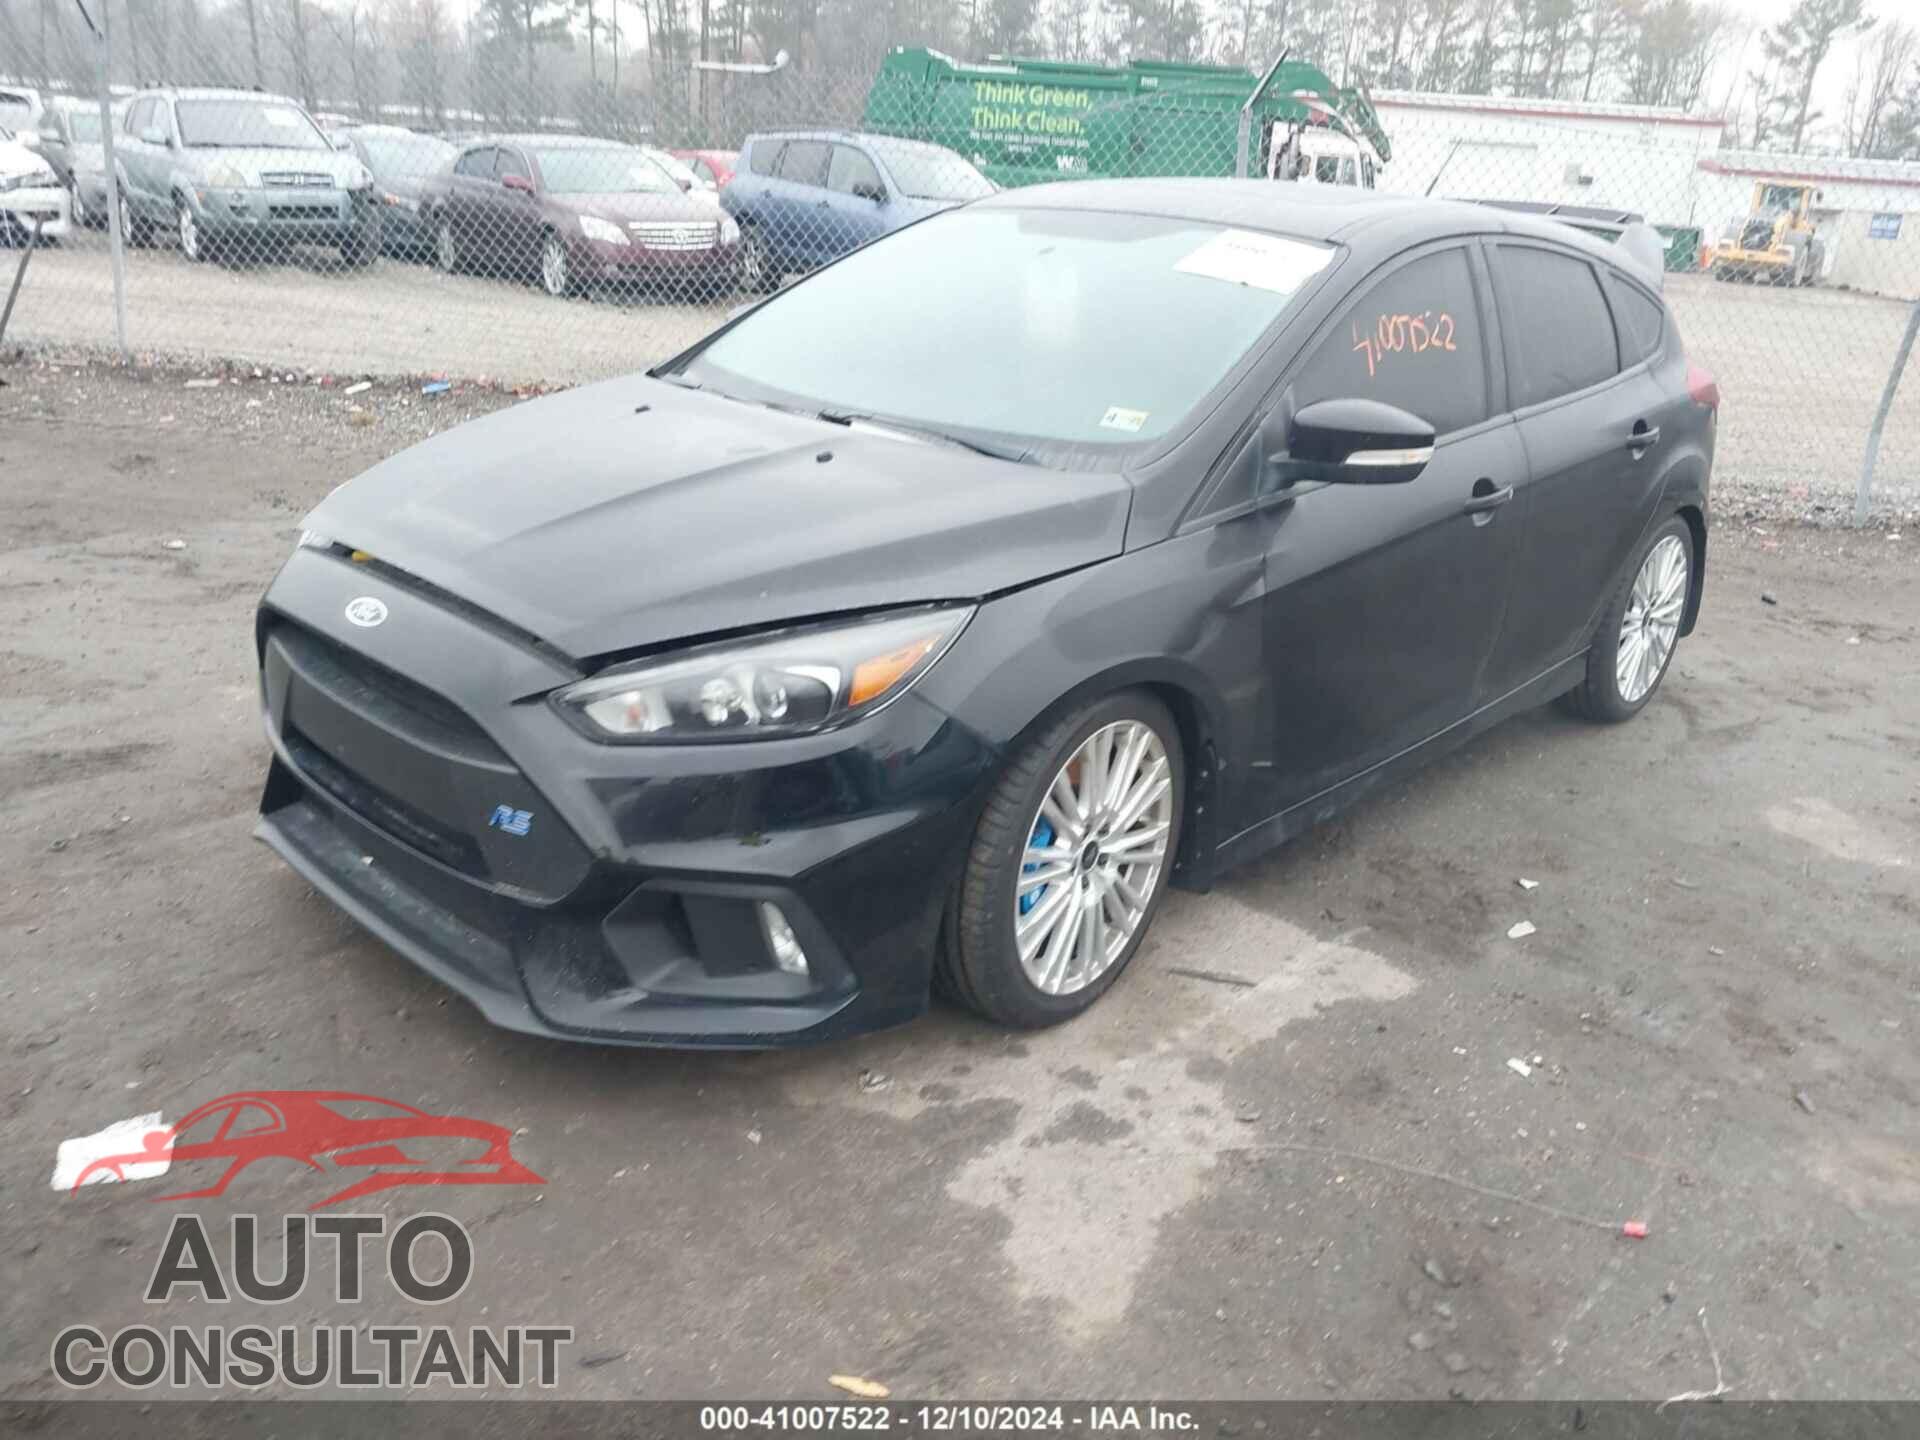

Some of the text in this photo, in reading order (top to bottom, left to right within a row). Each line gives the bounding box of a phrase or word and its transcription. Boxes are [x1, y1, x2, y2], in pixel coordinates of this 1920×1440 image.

[974, 81, 1094, 112] Think Green,
[972, 107, 1023, 130] Think
[488, 804, 535, 836] RS
